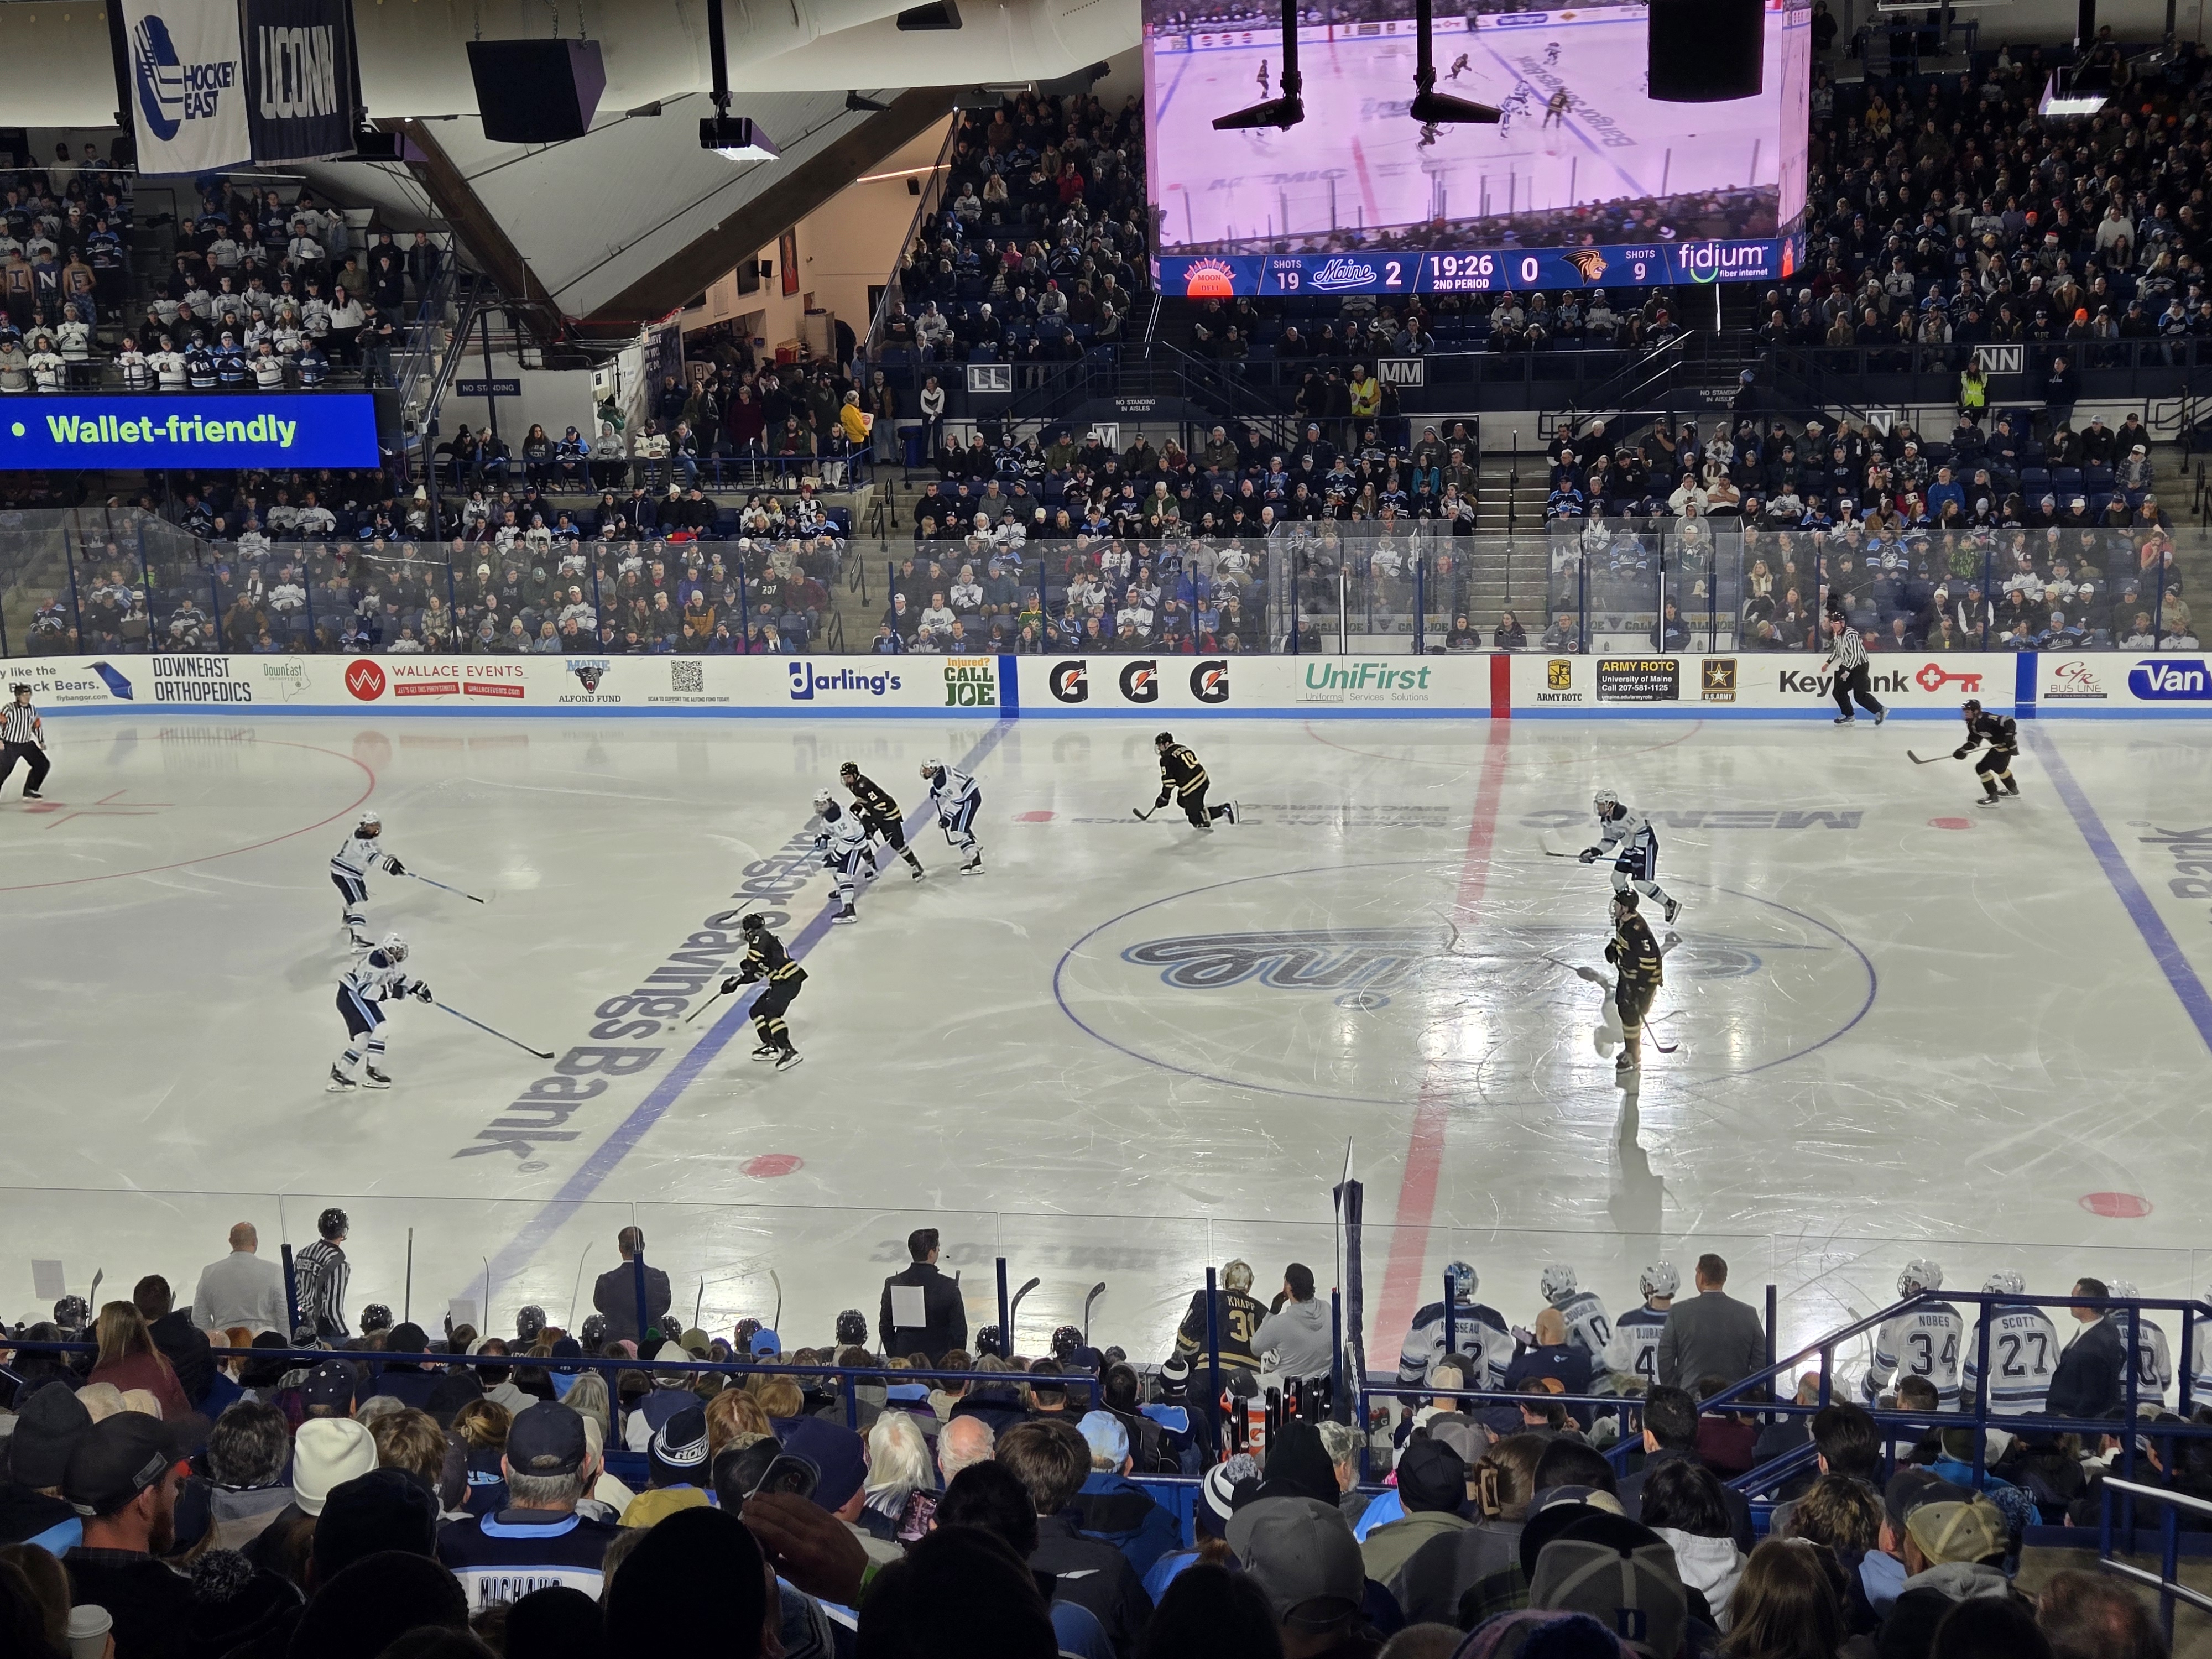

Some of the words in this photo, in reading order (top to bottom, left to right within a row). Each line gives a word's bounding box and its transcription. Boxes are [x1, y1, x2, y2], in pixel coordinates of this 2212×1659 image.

[183, 61, 237, 91] HOCKEY
[259, 25, 337, 119] UCONN
[184, 90, 219, 120] EAST
[1626, 249, 1655, 259] SHOTS
[1679, 243, 1764, 269] fidium
[1274, 260, 1301, 269] SHOTS
[1310, 259, 1377, 286] Maine
[1385, 262, 1402, 285] 2
[1430, 255, 1493, 276] 19:26
[1521, 257, 1538, 281] 0
[1634, 263, 1646, 280] 9
[1719, 269, 1736, 278] fiber
[1738, 268, 1768, 277] internet
[39, 271, 56, 289] N
[1277, 273, 1300, 290] 19
[1433, 280, 1452, 290] 2ND
[1455, 279, 1489, 289] PERIOD
[1979, 349, 2019, 371] NN
[974, 368, 1005, 388] LL
[1382, 363, 1420, 383] MM
[46, 415, 297, 448] Wallet-friendly
[1871, 415, 1890, 436] N
[1095, 427, 1115, 447] M
[762, 585, 776, 594] 207
[11, 667, 32, 677] like
[36, 666, 56, 675] the
[153, 657, 229, 677] DOWNEAST
[263, 663, 302, 676] DownEast
[392, 665, 460, 677] WALLACE
[467, 665, 524, 677] EVENTS
[566, 659, 611, 672] MAINE
[947, 658, 990, 668] Injured?
[1602, 662, 1635, 671] ARMY
[1640, 661, 1674, 671] ROTC
[944, 667, 994, 682] CALL
[1049, 659, 1089, 703] G
[1119, 659, 1159, 703] G
[1190, 659, 1229, 703] G
[1306, 663, 1431, 689] UniFirst
[1601, 675, 1639, 684] University
[1780, 670, 1910, 697] Keynk
[2143, 665, 2204, 691] Van
[9, 681, 50, 693] Bck
[55, 680, 100, 691] Bears.
[155, 681, 252, 702] ORTHOPEDICS
[945, 682, 995, 707] JOE
[2051, 684, 2073, 692] BUS
[2077, 684, 2101, 692] LINE
[1537, 693, 1561, 701] ARMY
[1519, 810, 1864, 830] MEMC
[451, 1046, 666, 1160] Bank
[1227, 1295, 1255, 1311] KNAPP
[1229, 1310, 1255, 1343] 31
[1440, 1321, 1480, 1334] RSSEAU
[1919, 1314, 1950, 1328] NOBES
[2002, 1316, 2035, 1329] SCOTT
[1907, 1332, 1957, 1376] 34
[1997, 1331, 2048, 1377] 27
